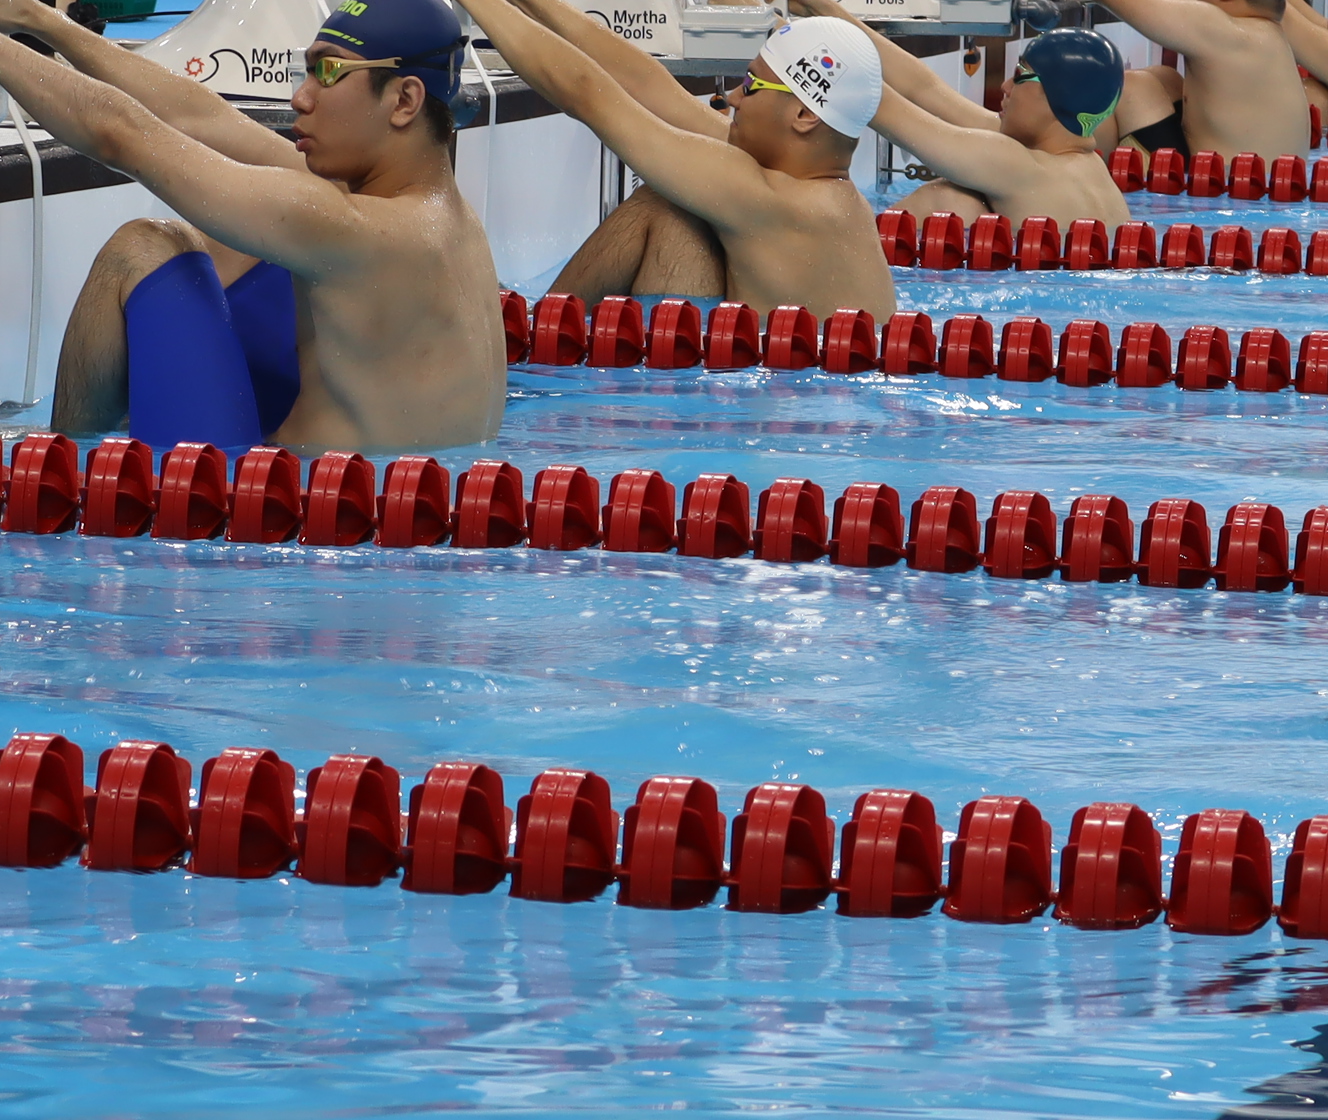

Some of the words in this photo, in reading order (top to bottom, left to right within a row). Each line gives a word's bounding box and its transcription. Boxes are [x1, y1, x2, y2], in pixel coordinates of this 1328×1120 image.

[614, 10, 667, 27] Myrtha
[252, 48, 292, 68] Myrt
[796, 57, 832, 95] KOR
